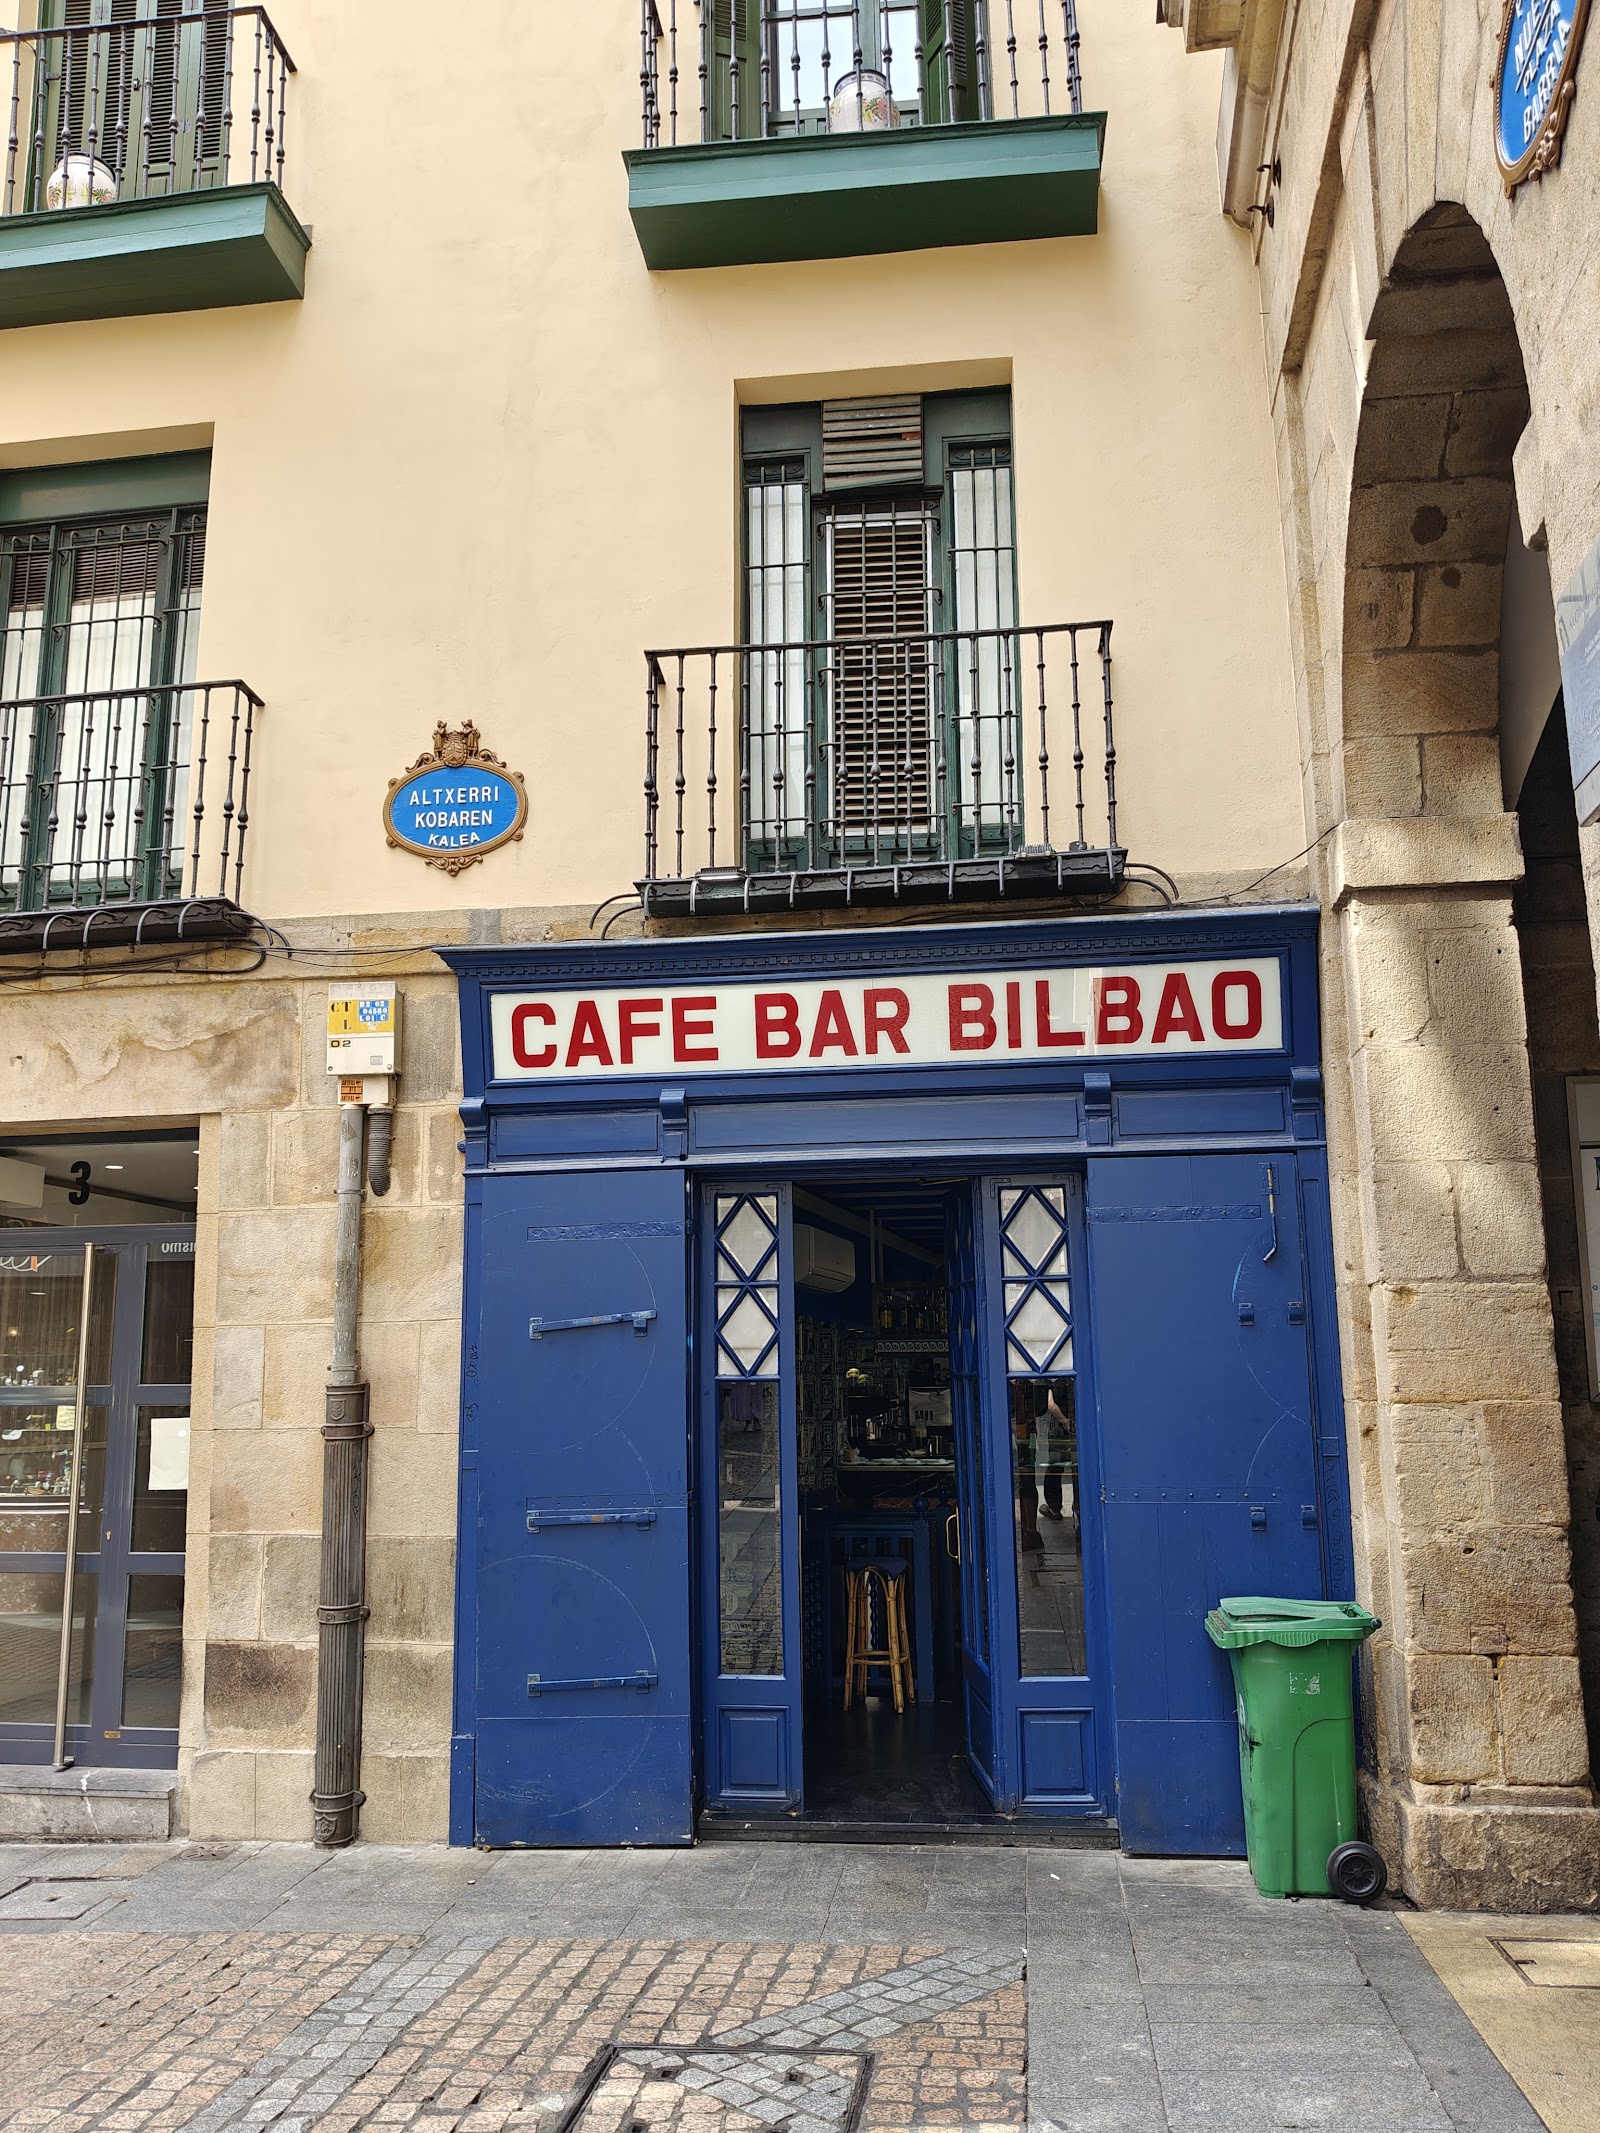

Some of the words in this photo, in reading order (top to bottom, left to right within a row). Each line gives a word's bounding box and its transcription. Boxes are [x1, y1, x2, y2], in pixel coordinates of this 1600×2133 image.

[1514, 0, 1546, 75] NUE
[1524, 0, 1561, 98] PLAZA
[1523, 19, 1572, 143] BARRIA
[409, 786, 499, 805] ALTXERRI
[415, 810, 493, 828] KOBAREN
[428, 832, 480, 847] KALEA
[511, 996, 719, 1068] CAFE
[754, 987, 910, 1059] BAR
[948, 970, 1263, 1051] BILBAO
[69, 1161, 91, 1205] 3
